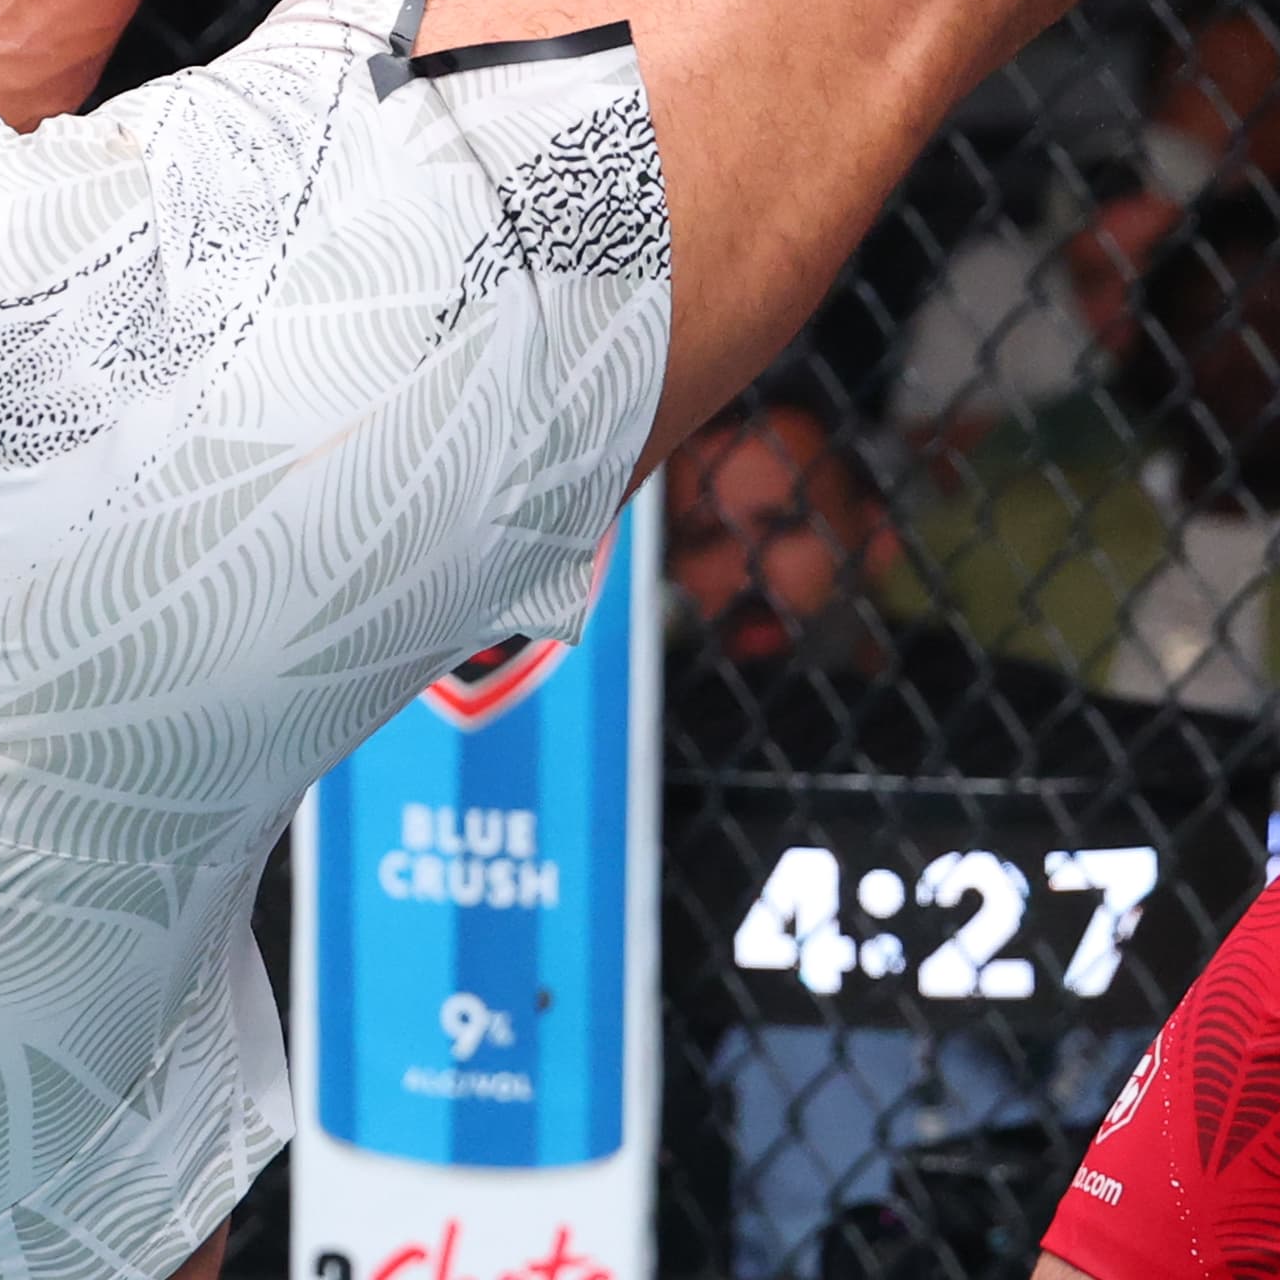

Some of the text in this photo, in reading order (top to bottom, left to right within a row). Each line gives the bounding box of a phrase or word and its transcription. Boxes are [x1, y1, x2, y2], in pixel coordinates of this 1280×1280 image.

[400, 800, 538, 861] BLUE
[377, 848, 561, 911] CRUSH
[732, 845, 1160, 1000] 4:27
